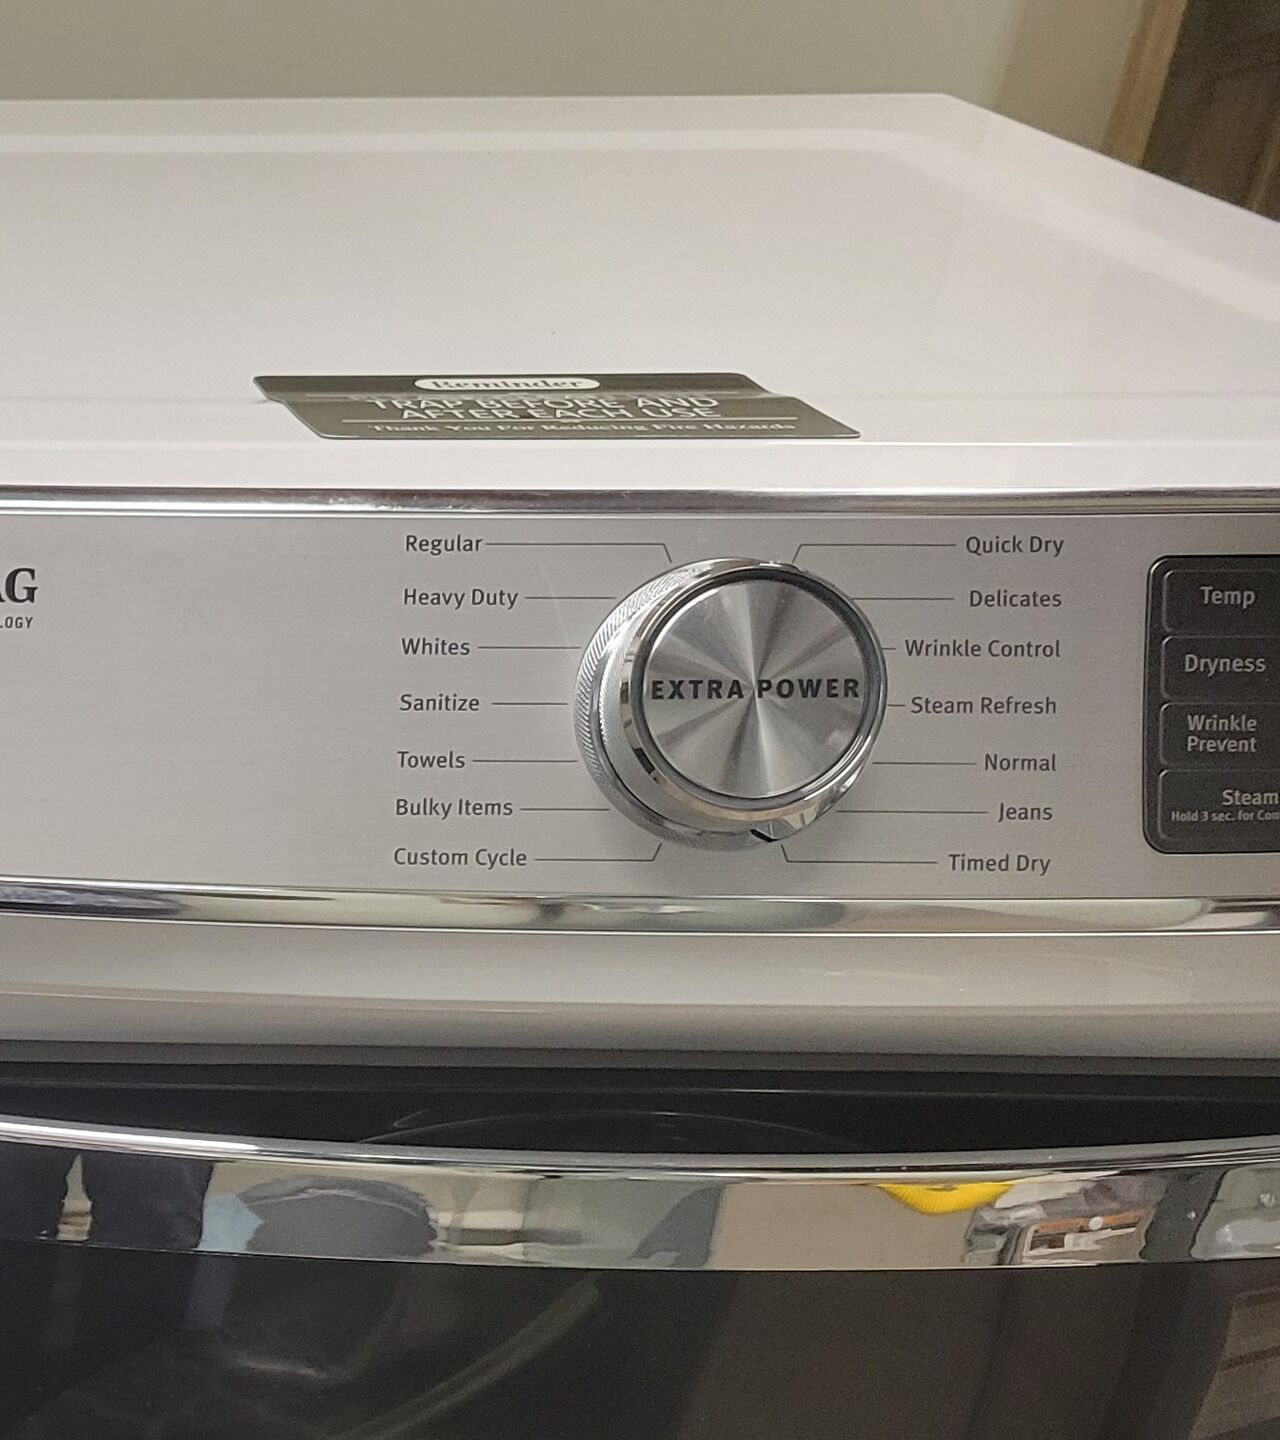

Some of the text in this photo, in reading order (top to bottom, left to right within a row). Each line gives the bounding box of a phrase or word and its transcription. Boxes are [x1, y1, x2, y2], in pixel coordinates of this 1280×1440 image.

[431, 379, 583, 389] Reminder
[367, 397, 719, 410] TRAP BEFORE AND
[401, 407, 721, 420] AFTER EACH USE
[405, 534, 483, 556] Regular
[966, 535, 1064, 557] Quick Dry
[403, 588, 518, 609] Heavy Duty
[970, 589, 1062, 607] Delicates
[1200, 586, 1256, 609] Temp
[401, 637, 470, 655] Whites
[905, 639, 1060, 657] Wrinkle Control
[1184, 654, 1266, 677] Dryness
[651, 678, 860, 700] EXTRA POWER
[399, 693, 480, 711] Sanitize
[910, 696, 1056, 714] Steam Refresh
[1187, 714, 1257, 732] Wrinkle
[1187, 736, 1257, 752] Prevent
[397, 751, 466, 768] Towels
[984, 753, 1056, 772] Normal
[1221, 789, 1279, 805] Steam
[396, 798, 513, 820] Bulky Items
[998, 803, 1053, 823] Jeans
[1171, 810, 1254, 822] Hold sec. for
[394, 848, 527, 870] Custom Cycle
[948, 853, 1051, 876] Timed Dry
